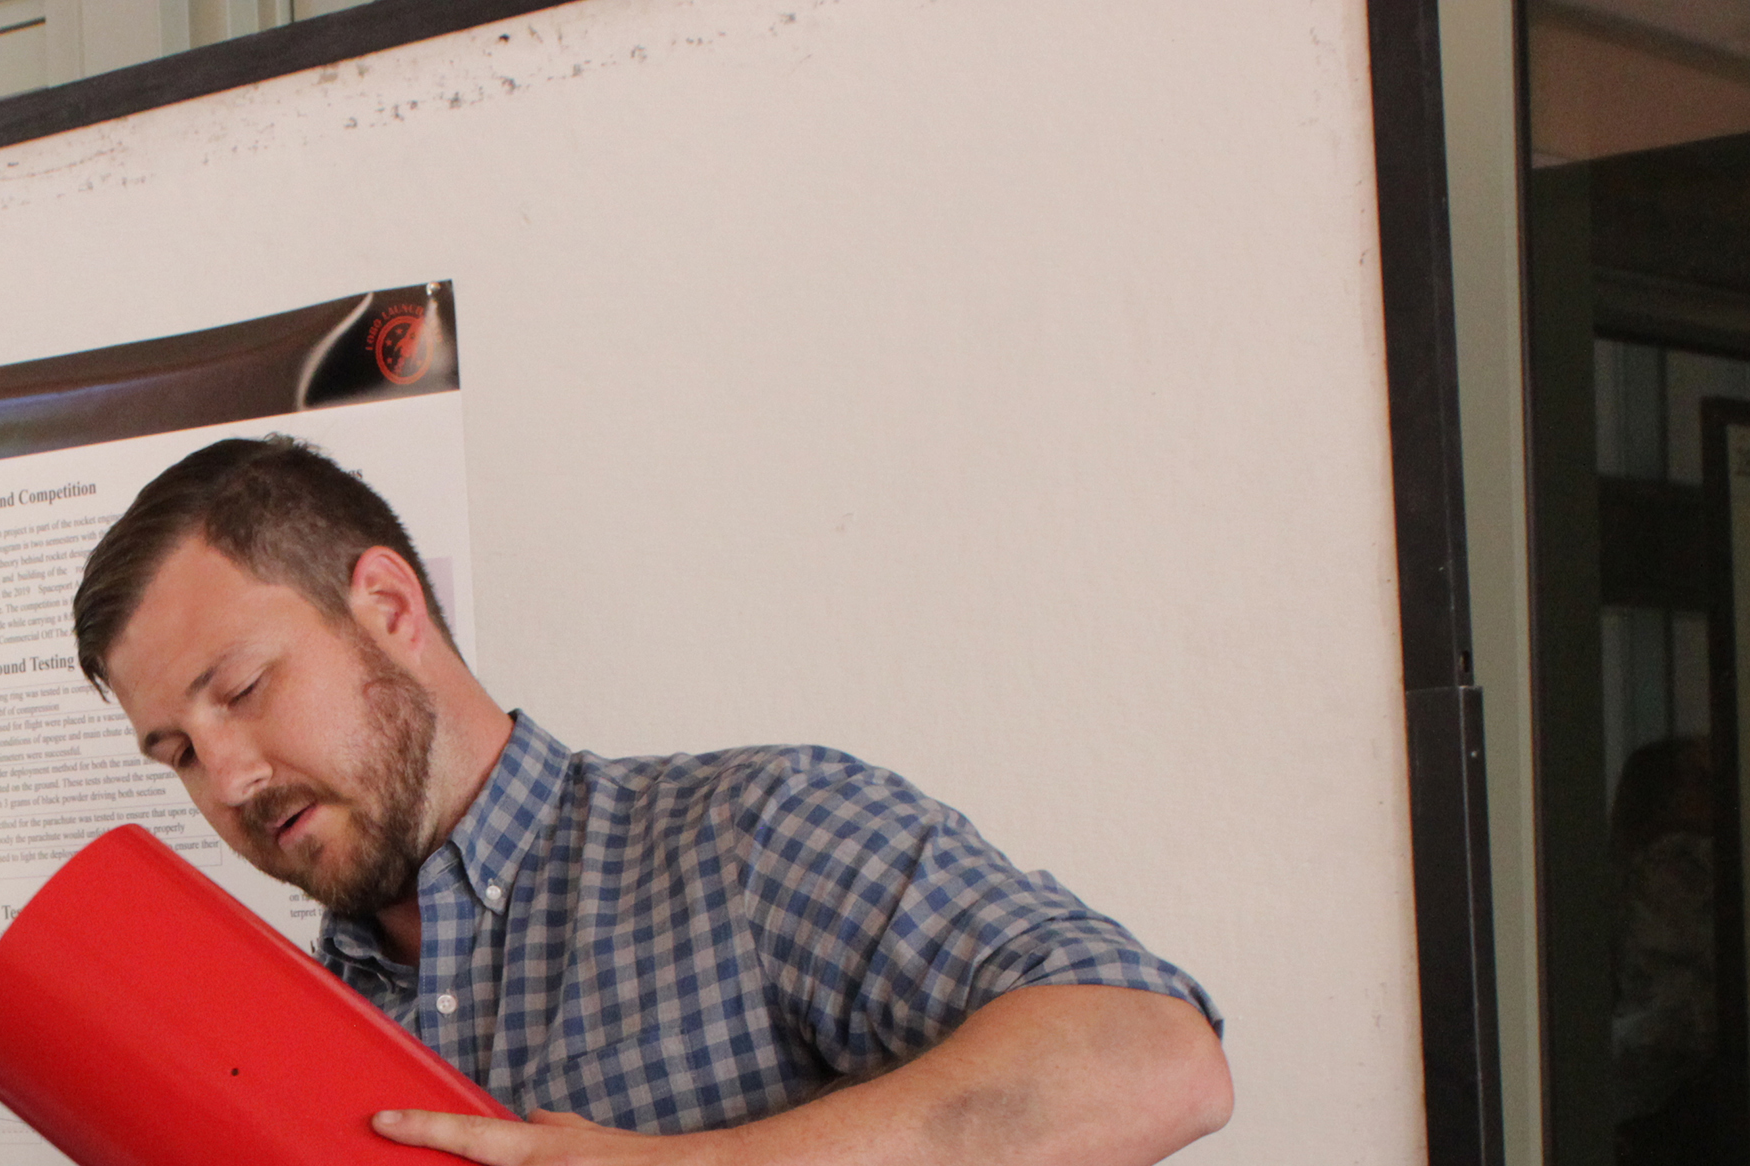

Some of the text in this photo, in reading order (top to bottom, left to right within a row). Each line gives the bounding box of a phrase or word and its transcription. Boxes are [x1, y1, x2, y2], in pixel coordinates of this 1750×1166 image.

[366, 303, 424, 350] LOBO LAUNCH
[18, 483, 96, 506] Competition
[3, 525, 26, 540] project
[36, 522, 49, 535] part
[60, 518, 71, 528] the
[73, 514, 95, 526] rocket
[32, 655, 74, 671] Testing
[154, 821, 184, 836] properly
[174, 839, 218, 851] ensure their
[290, 908, 317, 920] terpret
